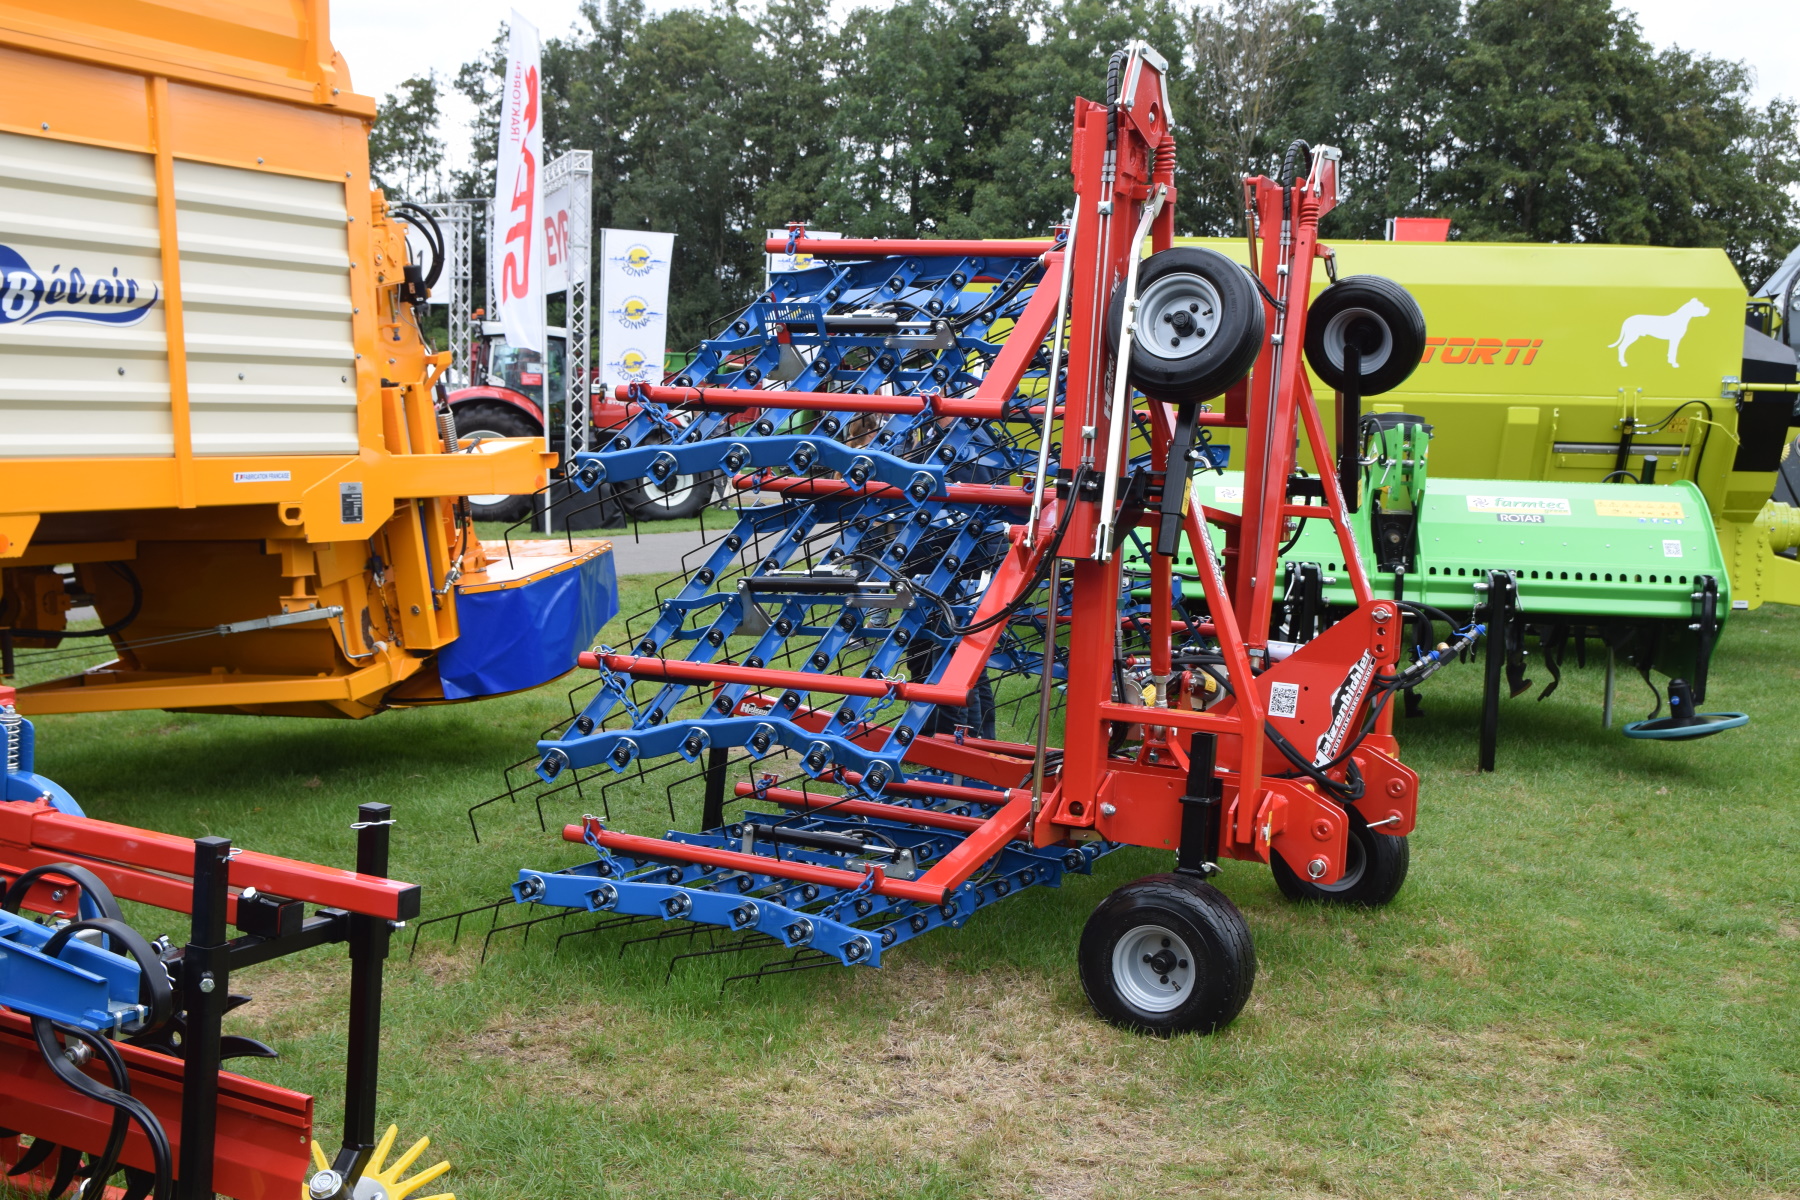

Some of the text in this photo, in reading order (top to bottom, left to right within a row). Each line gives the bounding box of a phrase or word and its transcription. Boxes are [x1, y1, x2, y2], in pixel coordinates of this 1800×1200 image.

[2, 264, 139, 320] Bélair
[1420, 337, 1543, 365] TORTI
[1494, 498, 1565, 509] farmtec
[1500, 514, 1541, 523] ROTAR
